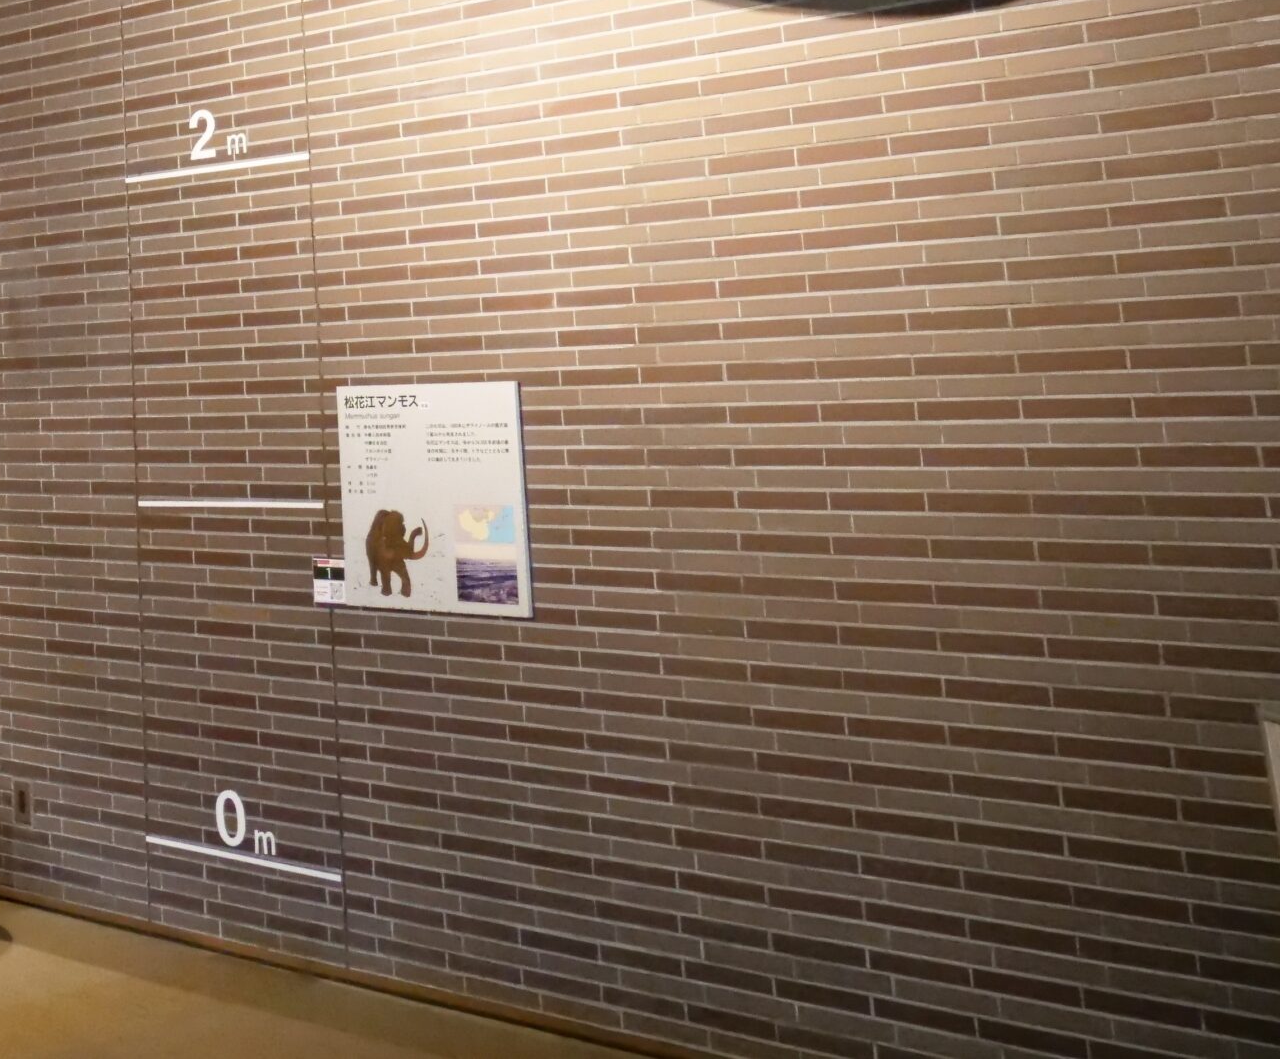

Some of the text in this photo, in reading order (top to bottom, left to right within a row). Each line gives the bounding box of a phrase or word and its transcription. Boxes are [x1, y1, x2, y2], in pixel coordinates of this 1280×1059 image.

[188, 109, 247, 161] 2m
[344, 395, 419, 409] 松花江マンモス
[325, 567, 332, 580] 1
[215, 789, 276, 856] 0m
